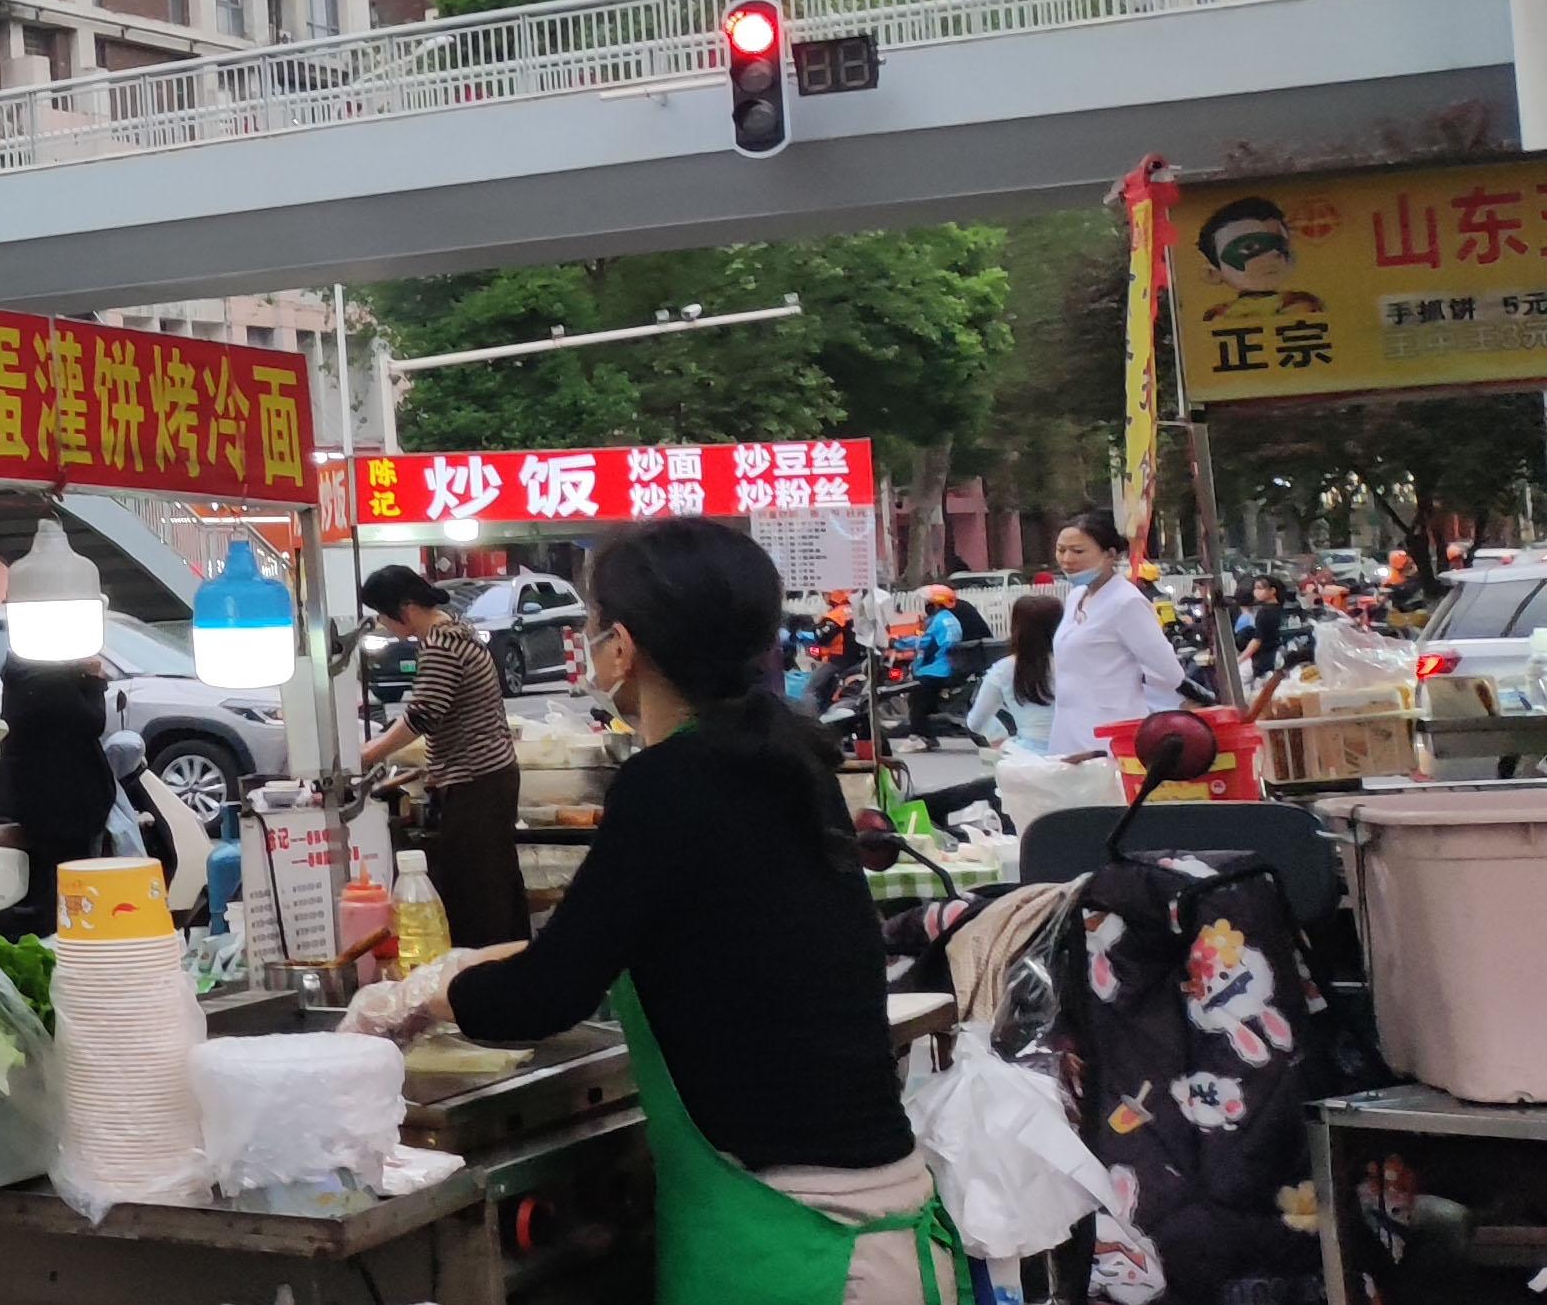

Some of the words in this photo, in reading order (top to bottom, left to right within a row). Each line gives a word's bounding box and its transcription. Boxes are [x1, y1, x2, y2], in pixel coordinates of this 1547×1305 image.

[1372, 183, 1547, 269] 山东
[1386, 297, 1476, 325] 手抓饼
[1210, 320, 1334, 373] 正宗
[367, 458, 402, 517] 陈记
[423, 453, 600, 520] 炒饭
[627, 447, 703, 482] 炒面
[732, 442, 851, 479] 炒豆丝
[629, 481, 706, 517] 炒粉
[735, 477, 852, 513] 炒粉丝
